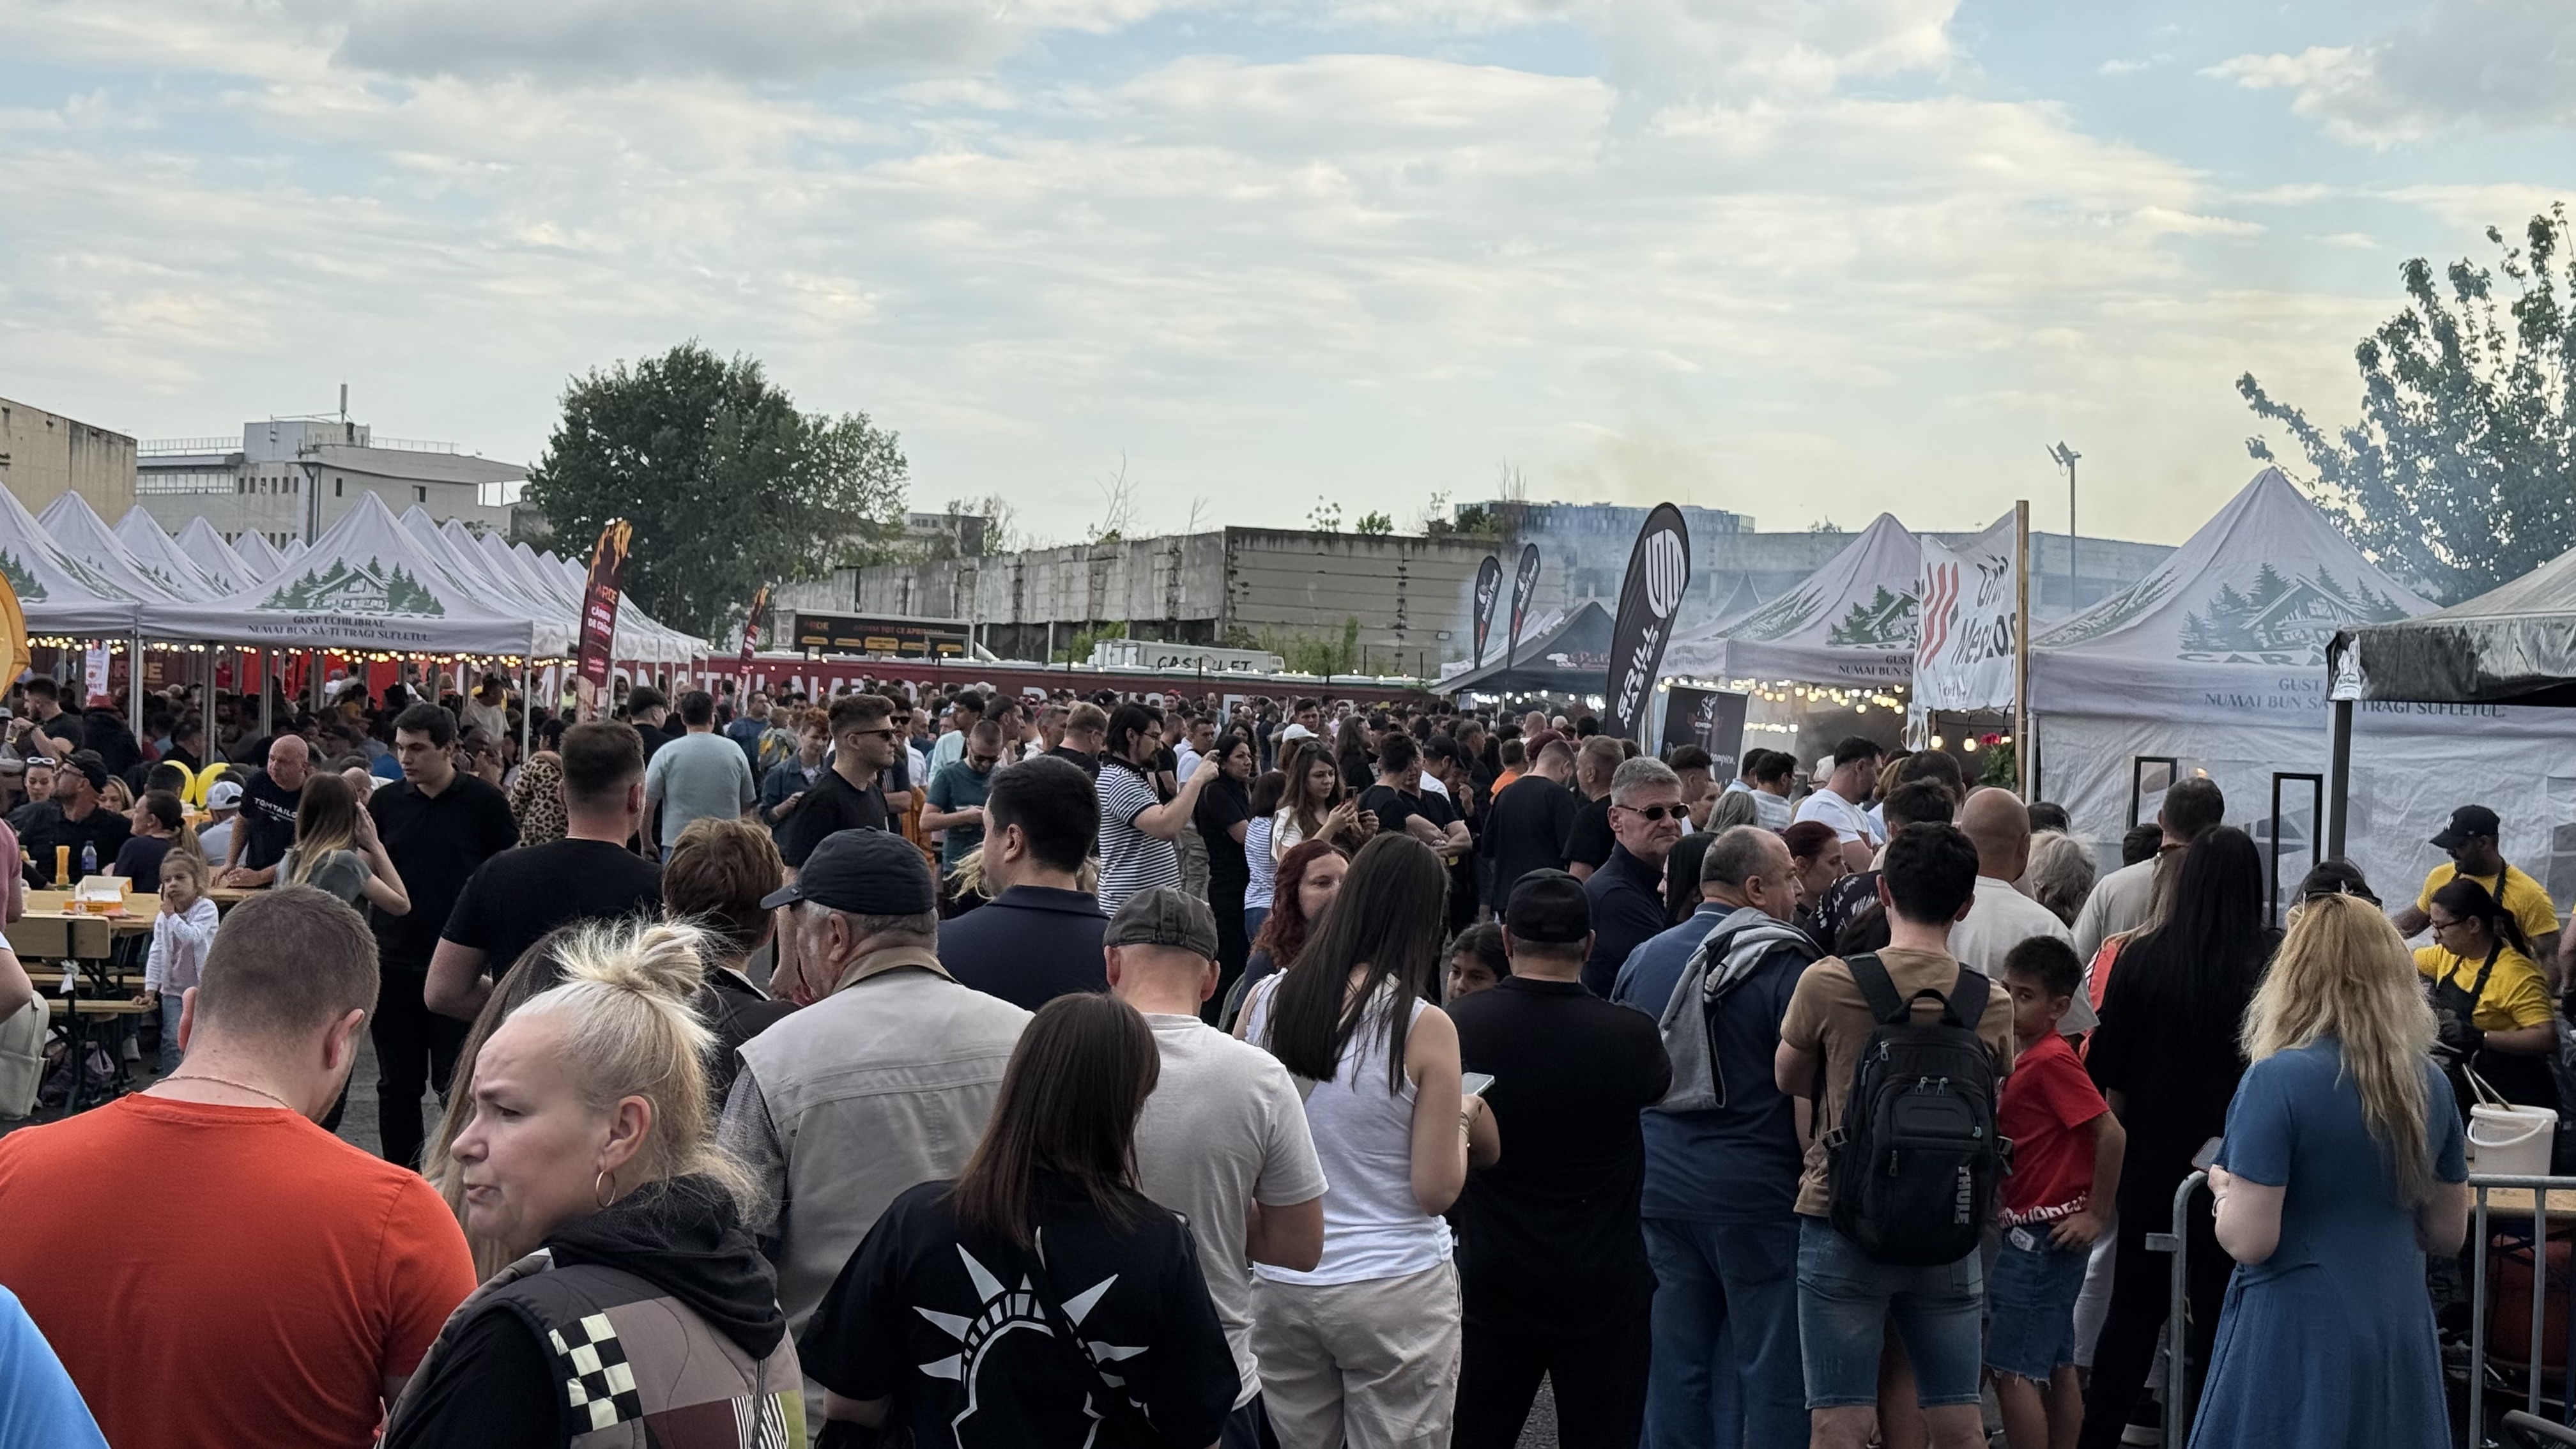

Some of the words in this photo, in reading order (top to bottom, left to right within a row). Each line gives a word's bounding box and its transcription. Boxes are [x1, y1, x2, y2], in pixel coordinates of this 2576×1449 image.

[293, 616, 320, 625] GUST
[248, 625, 283, 635] NUMAI
[286, 625, 308, 635] BUN
[343, 627, 375, 638] TRAGI
[1885, 654, 1913, 665] GUST
[1617, 624, 1655, 719] GRILL
[1838, 664, 1875, 676] NUMAI
[1878, 666, 1901, 677] BUN
[2278, 677, 2322, 692] GUST
[2204, 693, 2262, 708] NUMAI
[2268, 694, 2302, 709] BUN
[1954, 1163, 1972, 1225] THULE
